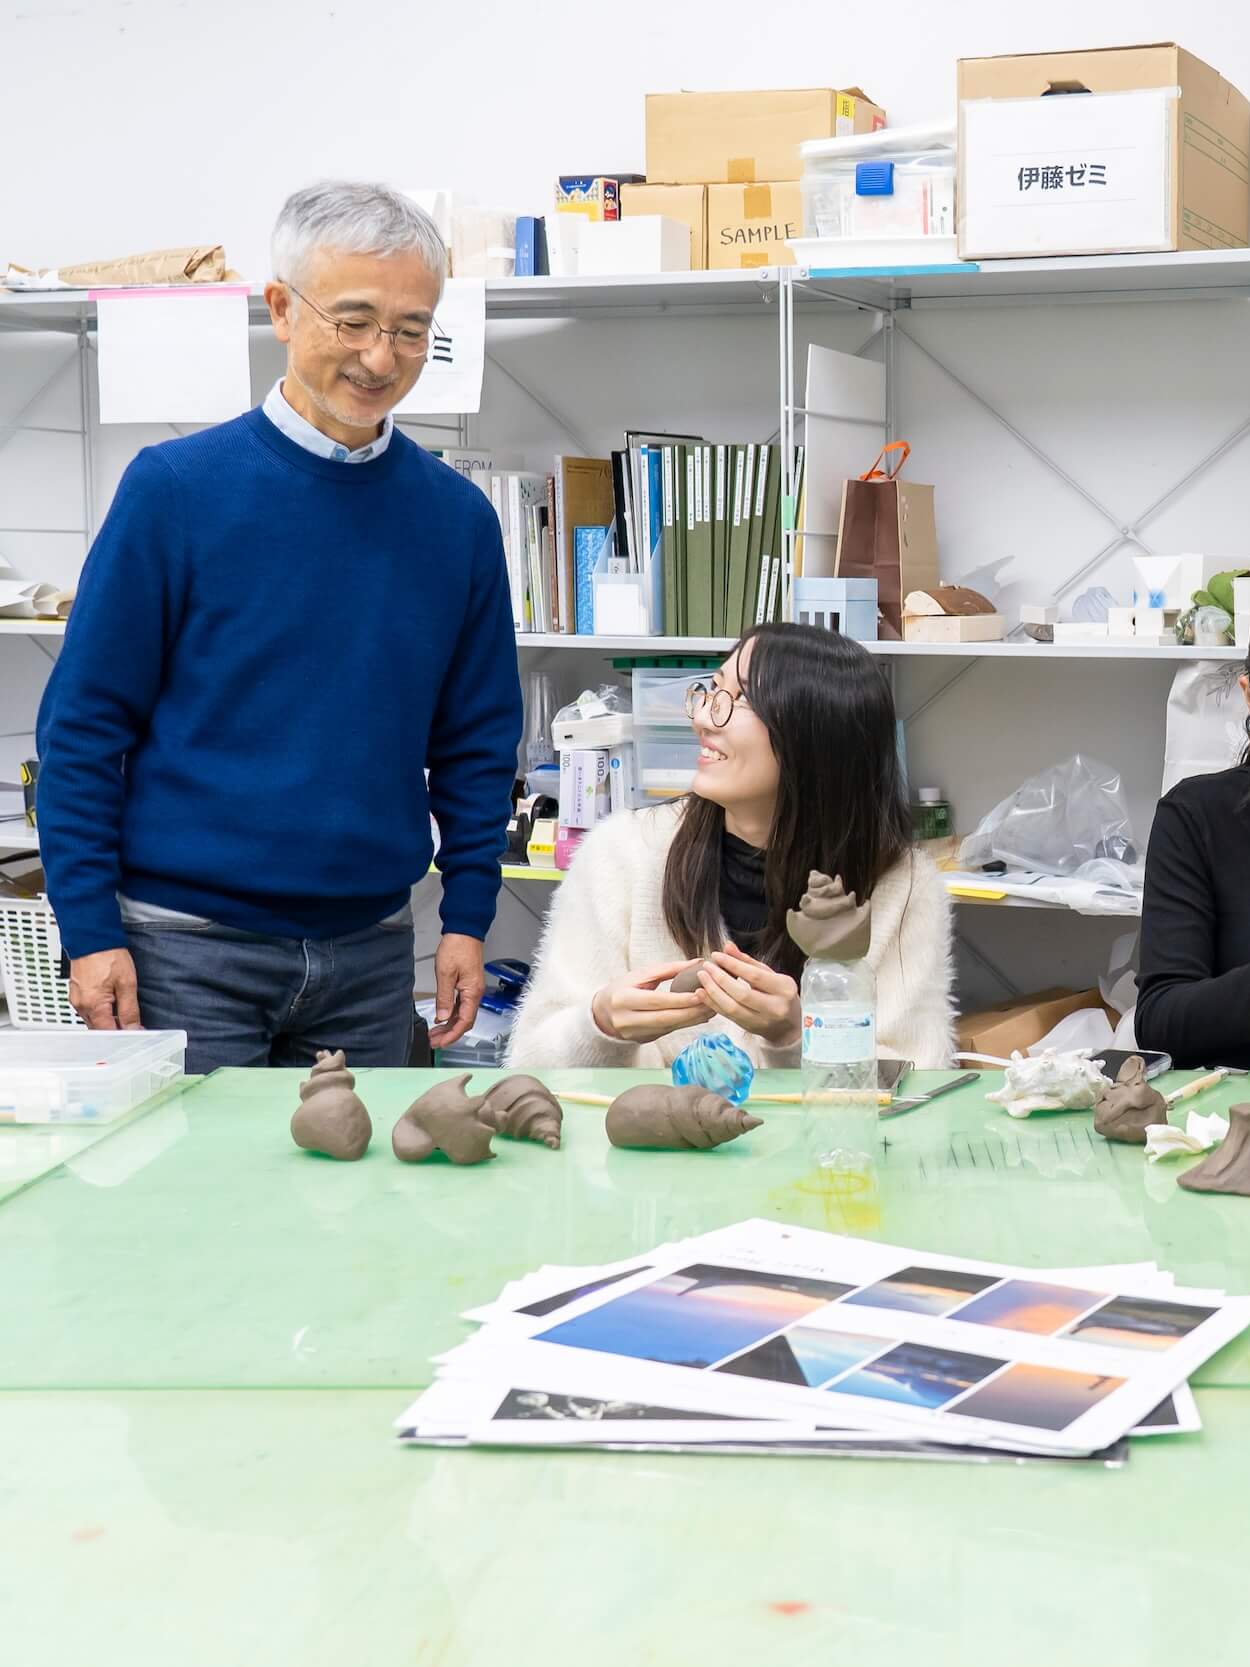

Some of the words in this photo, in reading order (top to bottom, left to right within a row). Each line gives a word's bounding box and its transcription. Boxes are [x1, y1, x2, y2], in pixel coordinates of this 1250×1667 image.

[1017, 163, 1107, 191] 伊藤ゼミ
[719, 222, 799, 246] SAMPLE
[430, 335, 453, 363] ミ
[597, 756, 605, 777] 100
